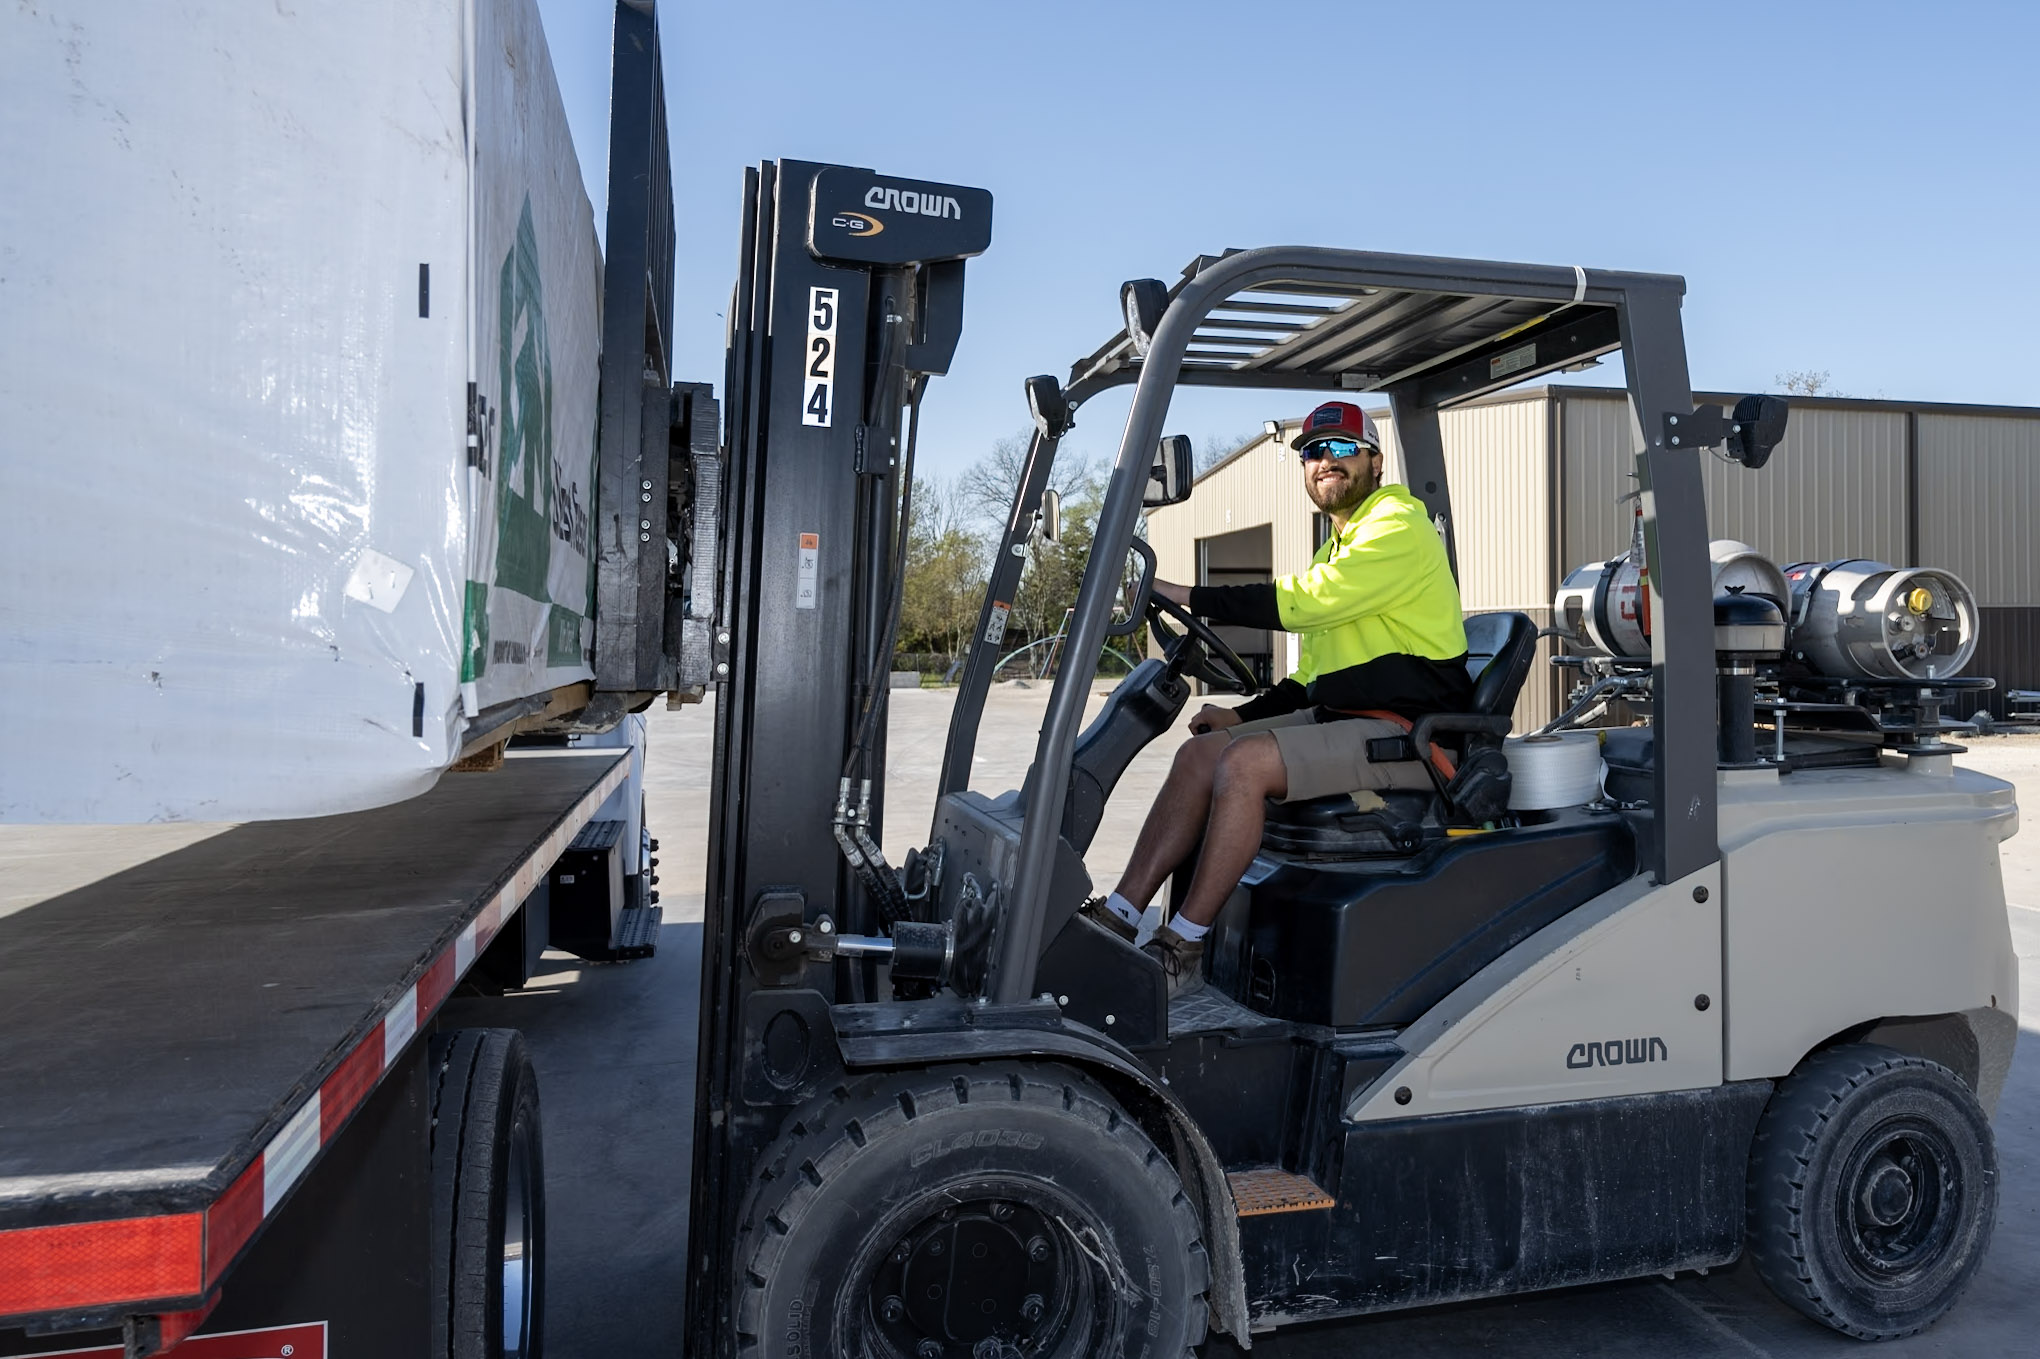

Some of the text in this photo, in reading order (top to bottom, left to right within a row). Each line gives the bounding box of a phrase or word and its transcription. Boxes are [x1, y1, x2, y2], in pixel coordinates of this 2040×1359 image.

[865, 186, 961, 220] CROWN
[807, 290, 834, 424] 524
[1566, 1036, 1667, 1069] CROWN
